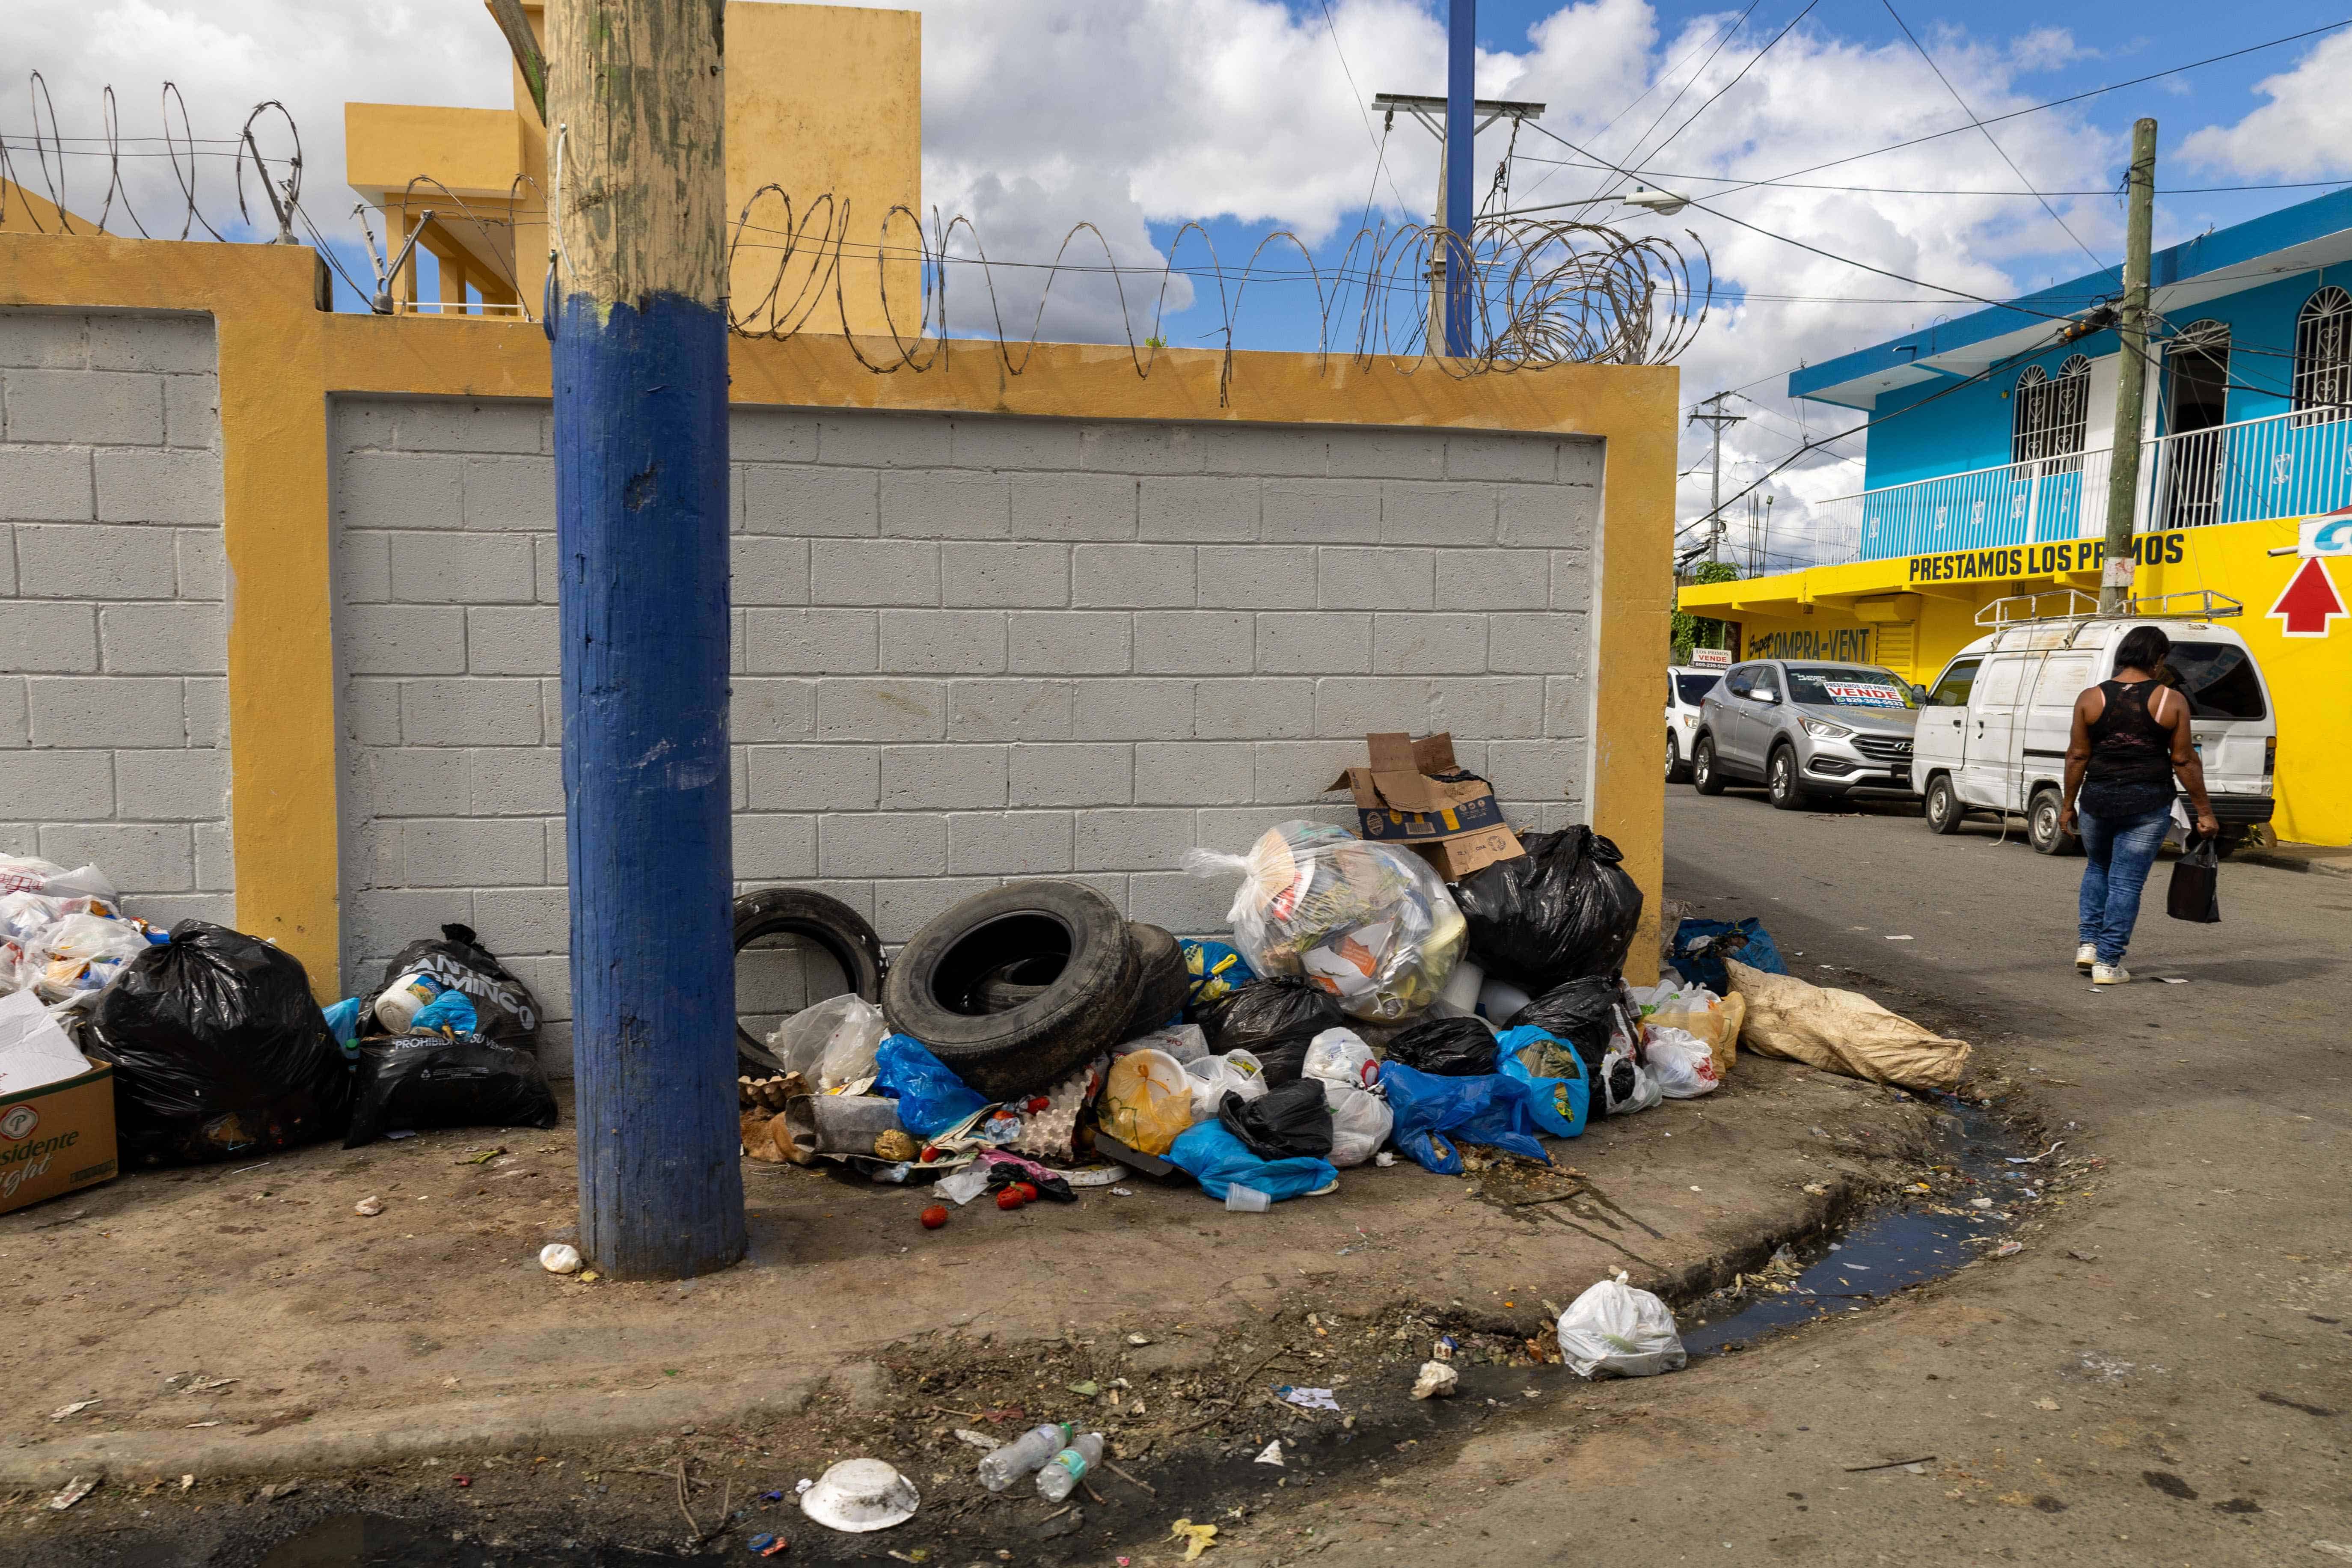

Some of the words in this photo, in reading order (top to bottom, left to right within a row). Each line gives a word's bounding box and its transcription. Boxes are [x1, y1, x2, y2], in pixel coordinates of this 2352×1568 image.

[1909, 549, 2022, 582] PRESTAMOS
[2028, 544, 2071, 574] LOS
[1766, 628, 1871, 663] COMPRA-VENT
[1828, 687, 1901, 701] VENDE
[0, 1131, 80, 1166] sidente
